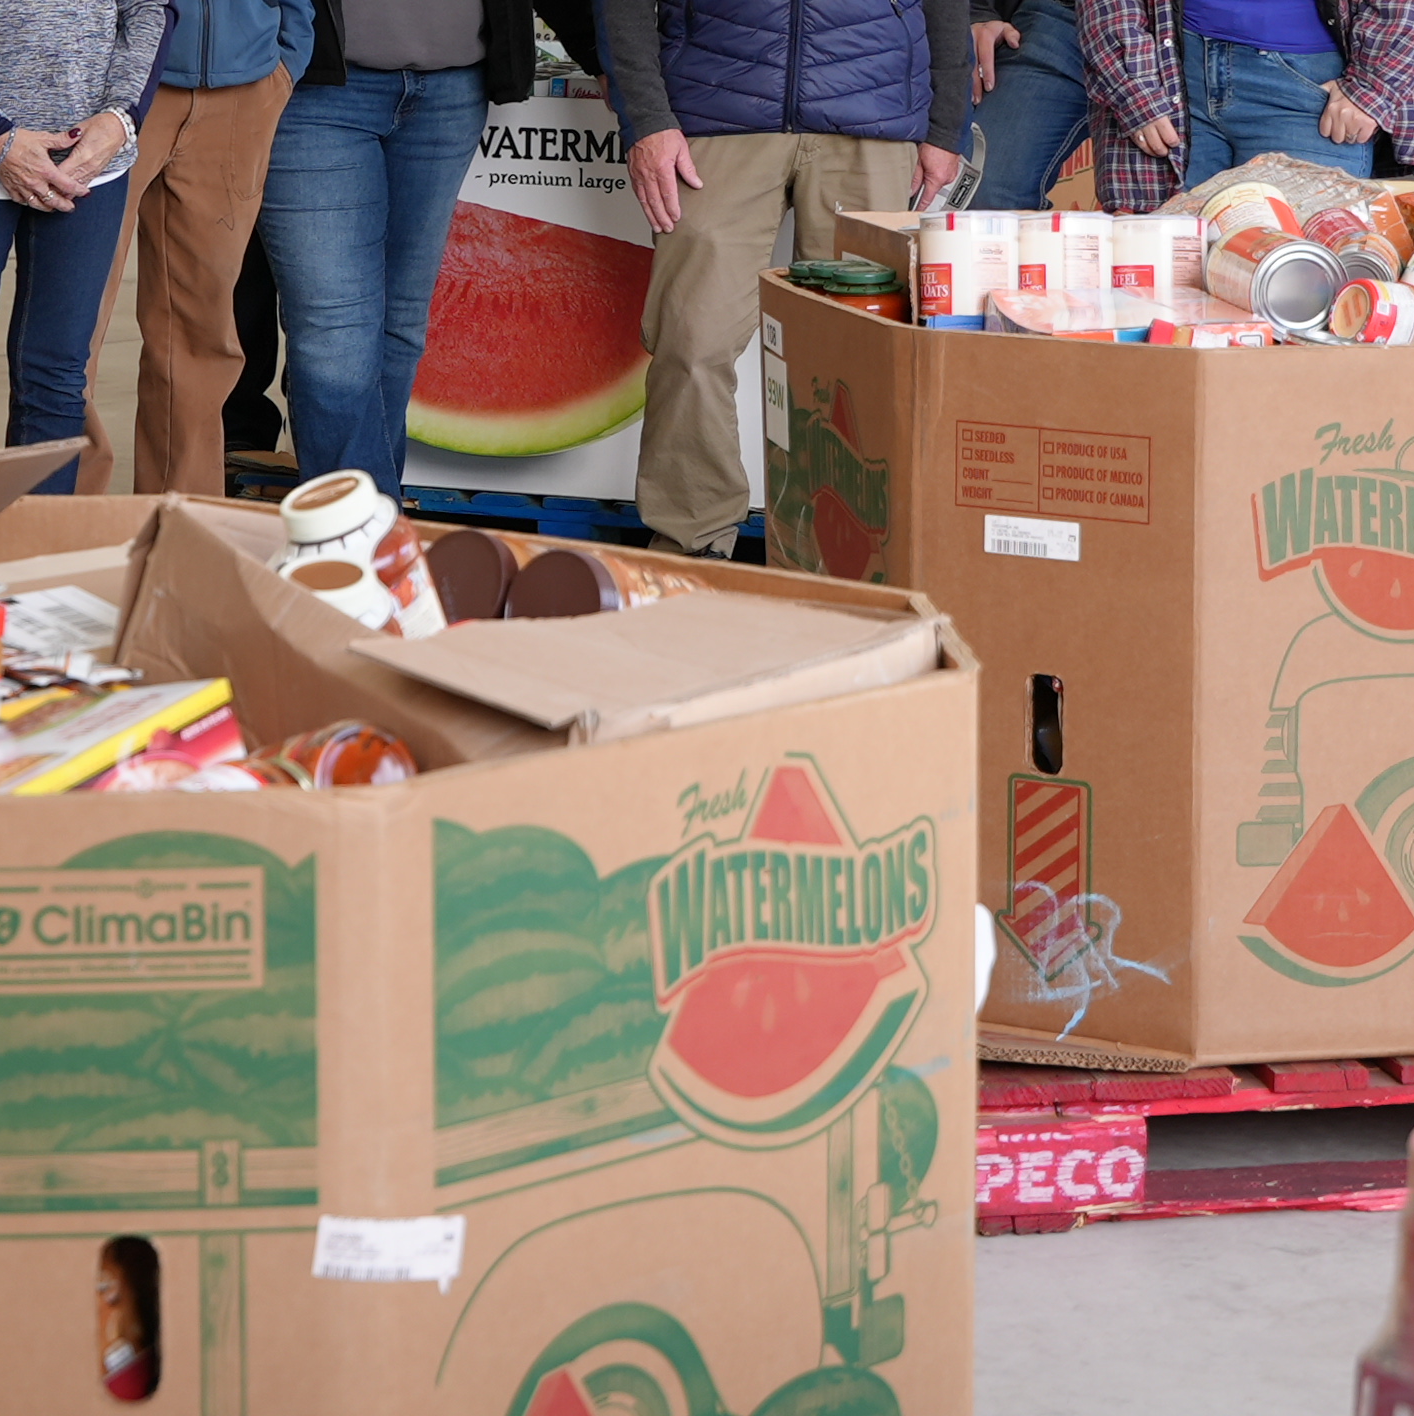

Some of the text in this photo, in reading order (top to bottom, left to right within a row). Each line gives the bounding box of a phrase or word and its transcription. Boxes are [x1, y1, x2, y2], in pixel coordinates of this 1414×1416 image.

[489, 171, 572, 187] premium
[579, 168, 626, 193] large
[923, 284, 949, 298] OATS
[766, 325, 777, 347] 108
[767, 376, 784, 411] 93W
[974, 430, 1006, 445] SEEDED
[1314, 418, 1395, 465] Fresh
[974, 449, 1015, 464] SEEDLESS
[1056, 442, 1127, 461] PRODUCE OF USA
[962, 467, 990, 480] COUNT
[1056, 466, 1143, 485] PRODUCE OF MEXICO
[961, 486, 993, 500] WEIGHT
[1056, 488, 1144, 508] PRODUCE OF CANADA
[676, 766, 748, 839] Fresh
[657, 830, 928, 990] WATERMELONS
[33, 902, 251, 945] ClimaBin
[975, 1145, 1145, 1203] PECO
